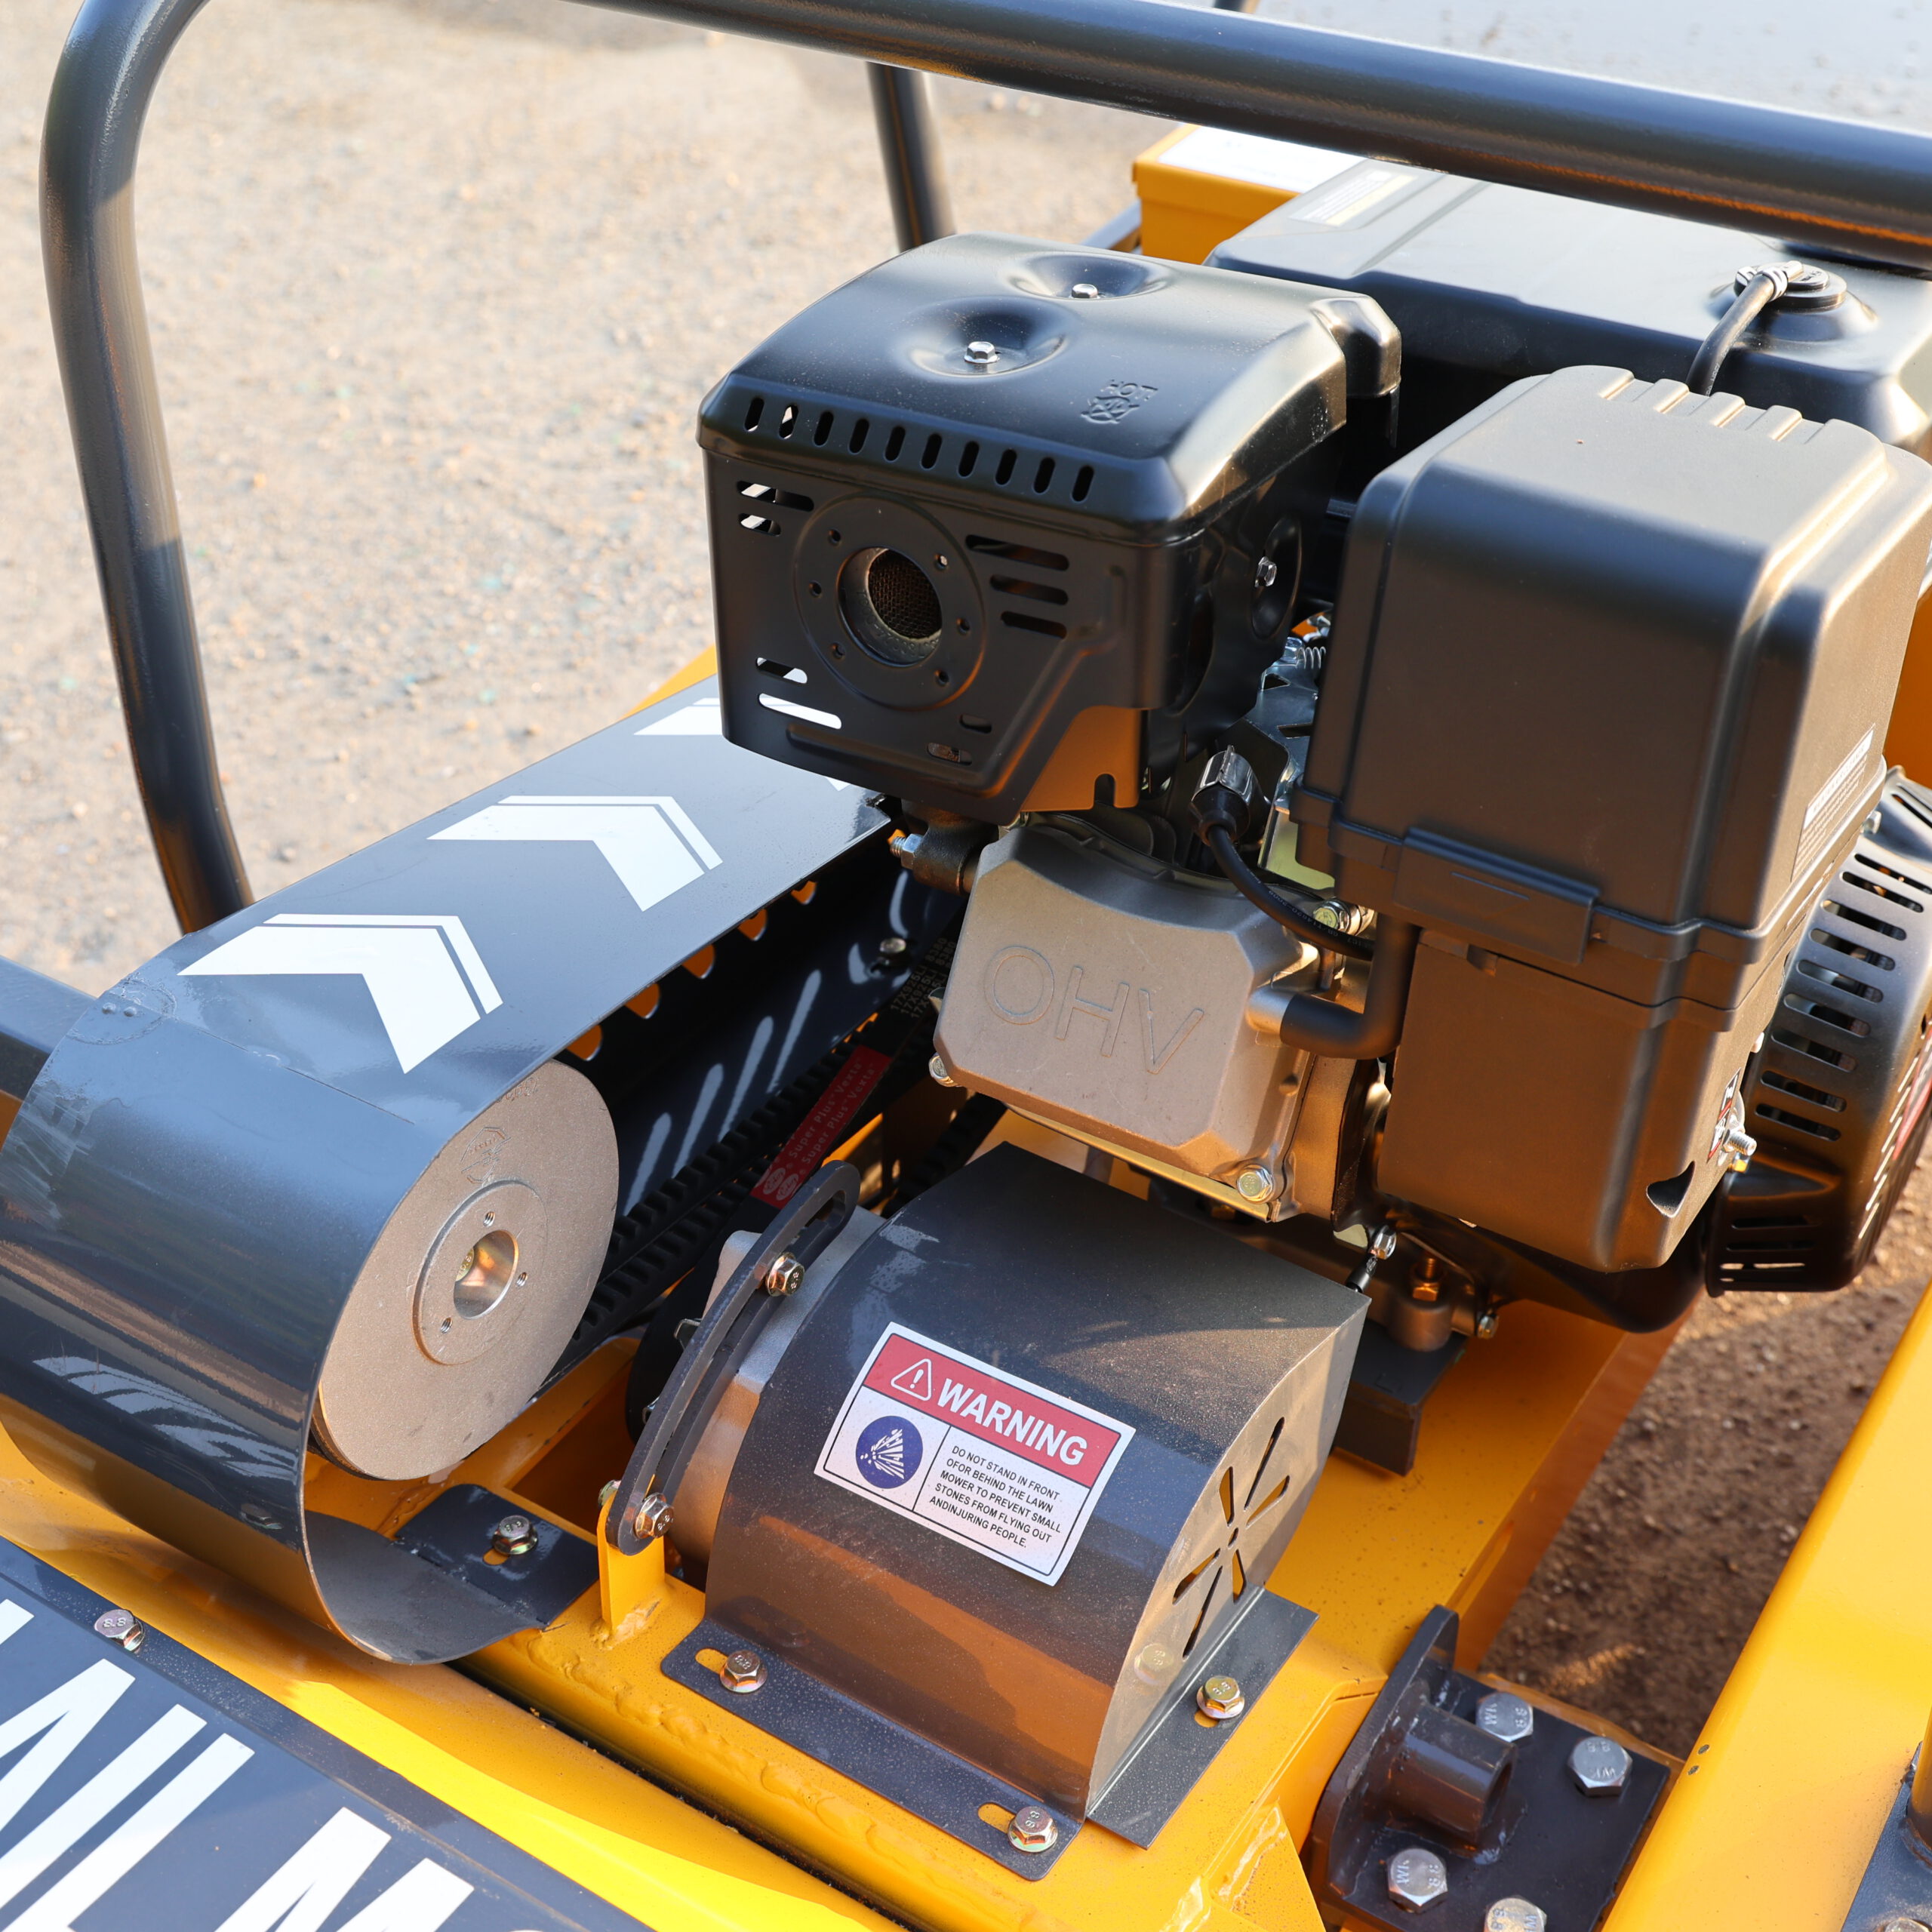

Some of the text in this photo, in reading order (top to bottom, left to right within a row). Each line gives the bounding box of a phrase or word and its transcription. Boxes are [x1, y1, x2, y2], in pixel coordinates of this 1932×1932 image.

[984, 945, 1204, 1075] OHV
[789, 1126, 816, 1158] Super
[802, 1131, 829, 1164] Super
[937, 1377, 1088, 1466] WARNING
[946, 1458, 1053, 1513] OFOR BEHIND THE LAWN
[952, 1445, 1060, 1500] DO NOT STAND IN FRONT
[929, 1496, 1026, 1548] ANDINJURING PEOPLE.
[935, 1483, 1052, 1543] STONES FROM FLYING OUT
[940, 1470, 1060, 1533] MOWER TO PREVENT SMALL
[103, 1617, 128, 1629] 8.8
[1524, 1914, 1537, 1932] W
